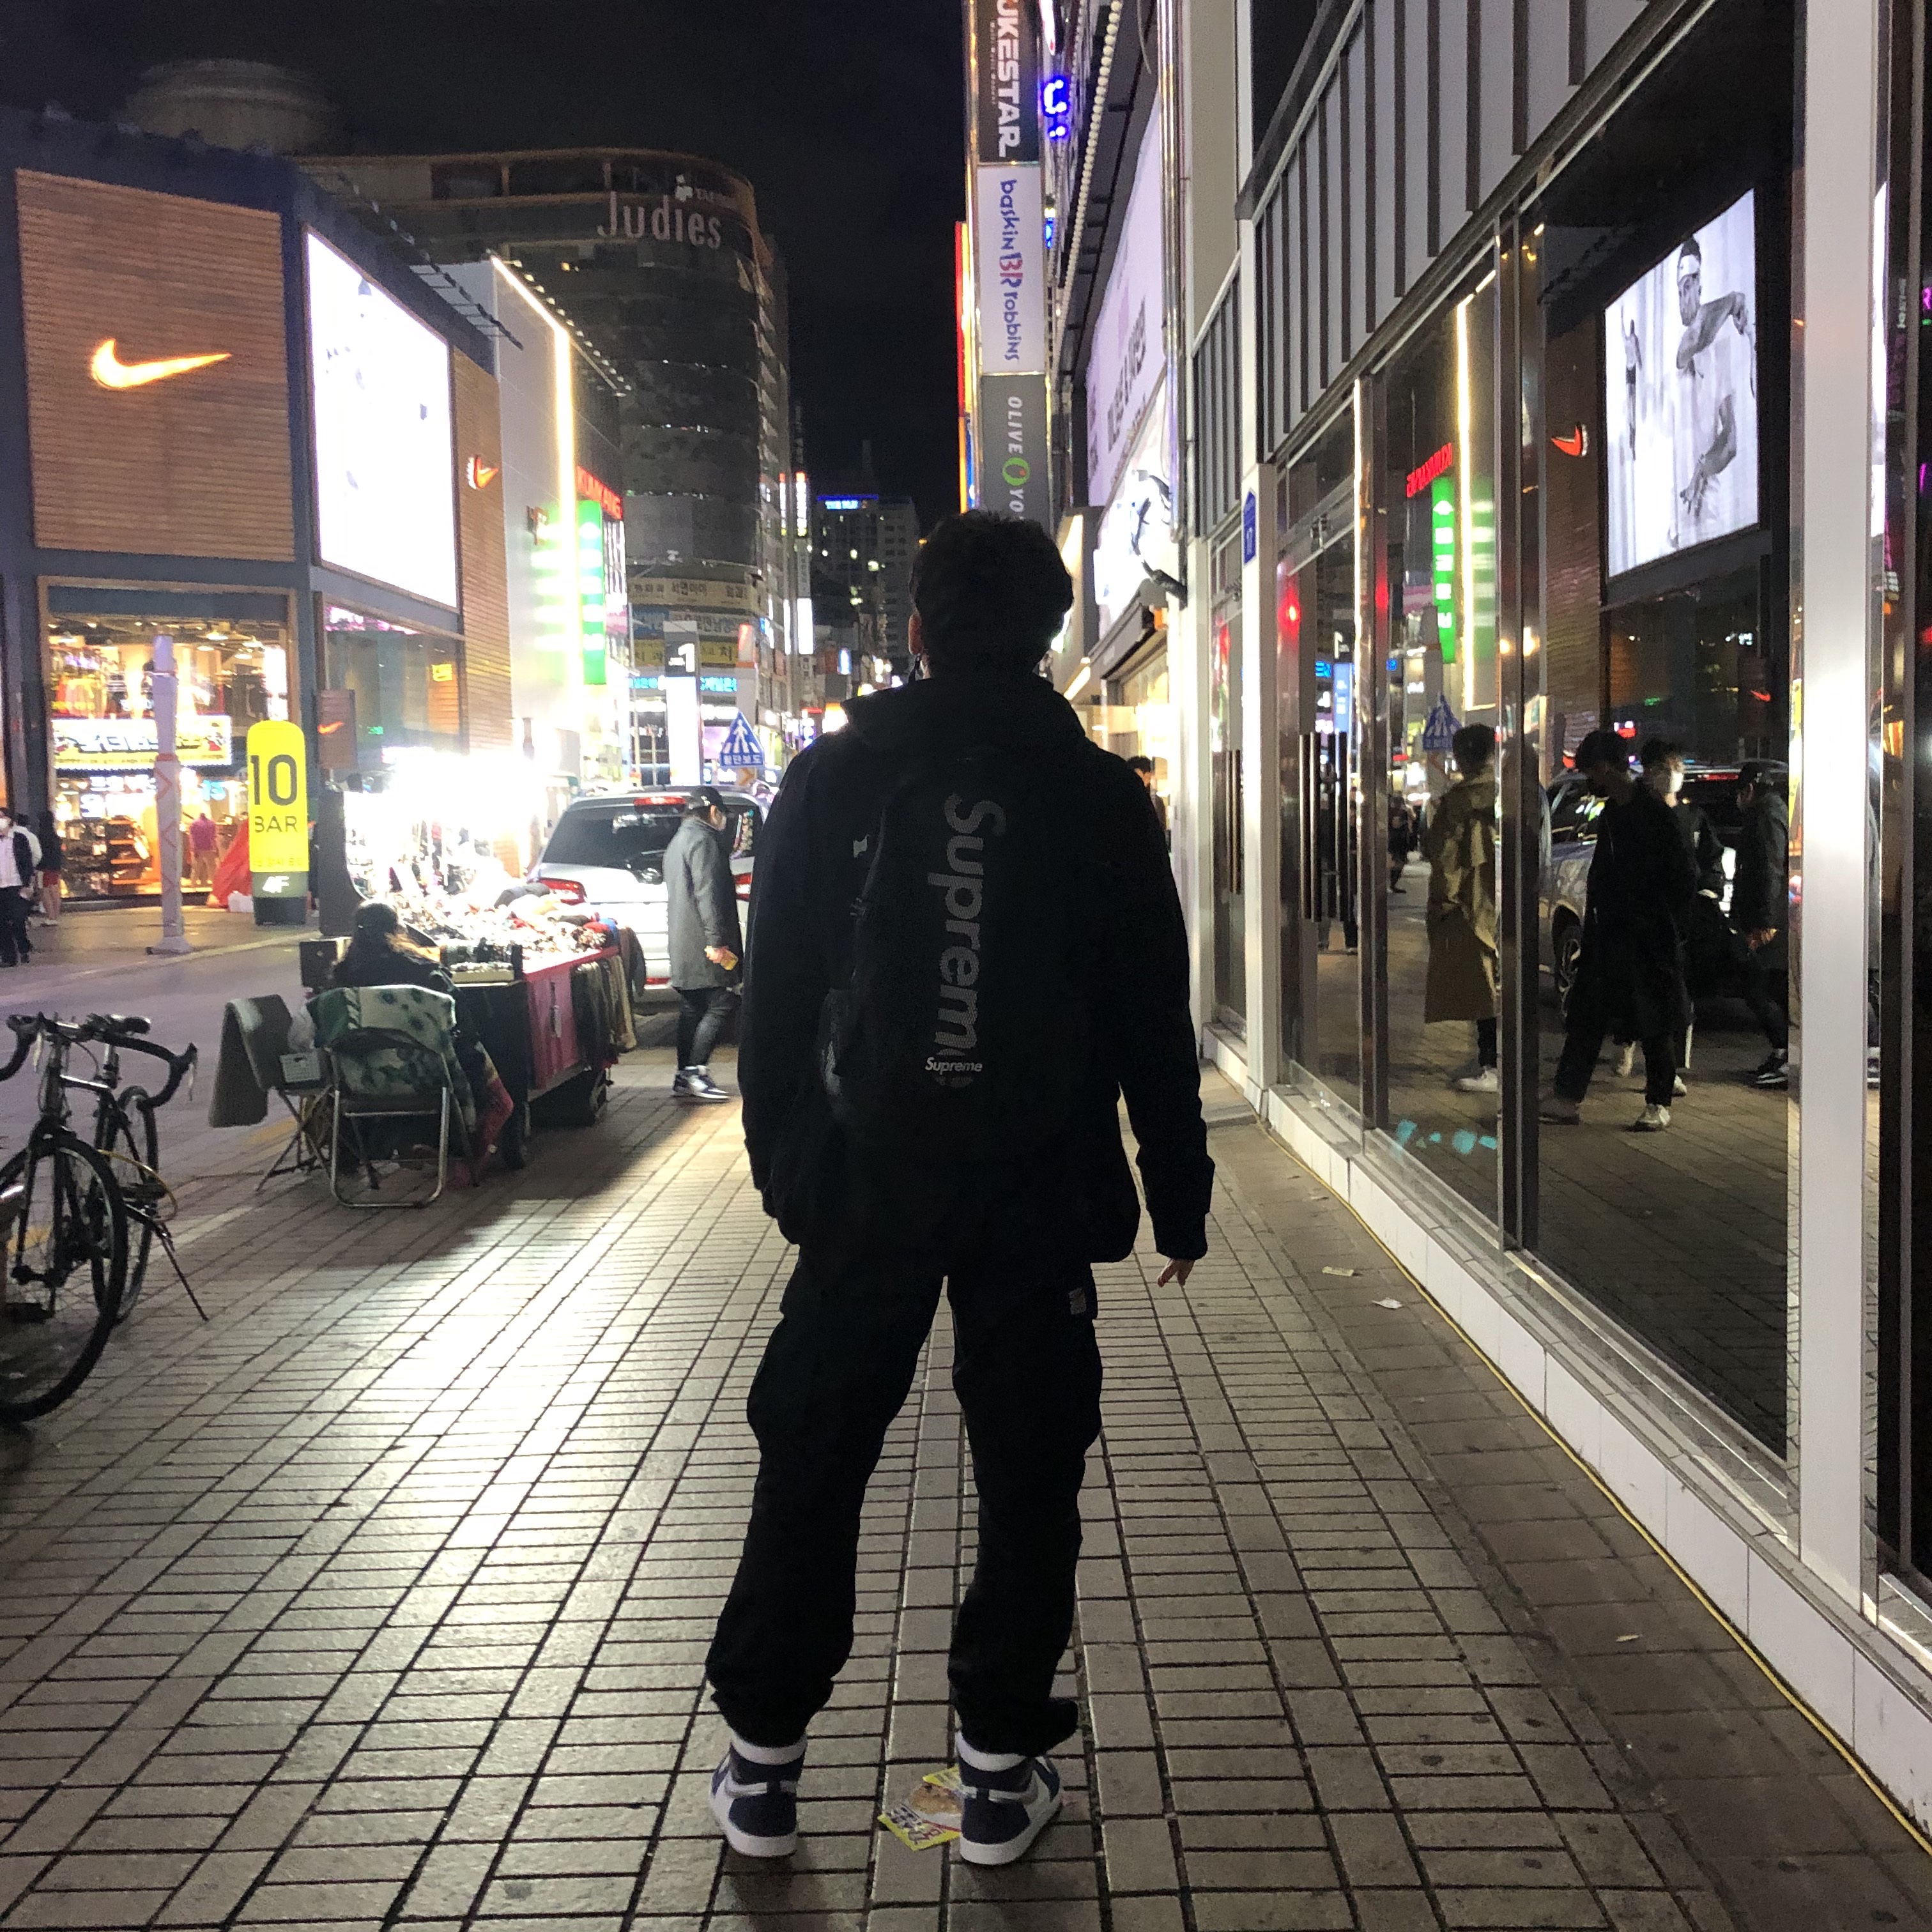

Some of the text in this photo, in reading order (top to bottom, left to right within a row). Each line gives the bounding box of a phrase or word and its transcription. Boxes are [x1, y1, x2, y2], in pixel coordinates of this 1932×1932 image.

[597, 191, 721, 249] Judies
[1000, 178, 1020, 250] baskin
[1003, 292, 1020, 363] robbins
[1008, 396, 1023, 454] OLIVE
[250, 754, 298, 806] 10
[254, 816, 298, 833] BAR
[924, 1056, 983, 1075] Supreme
